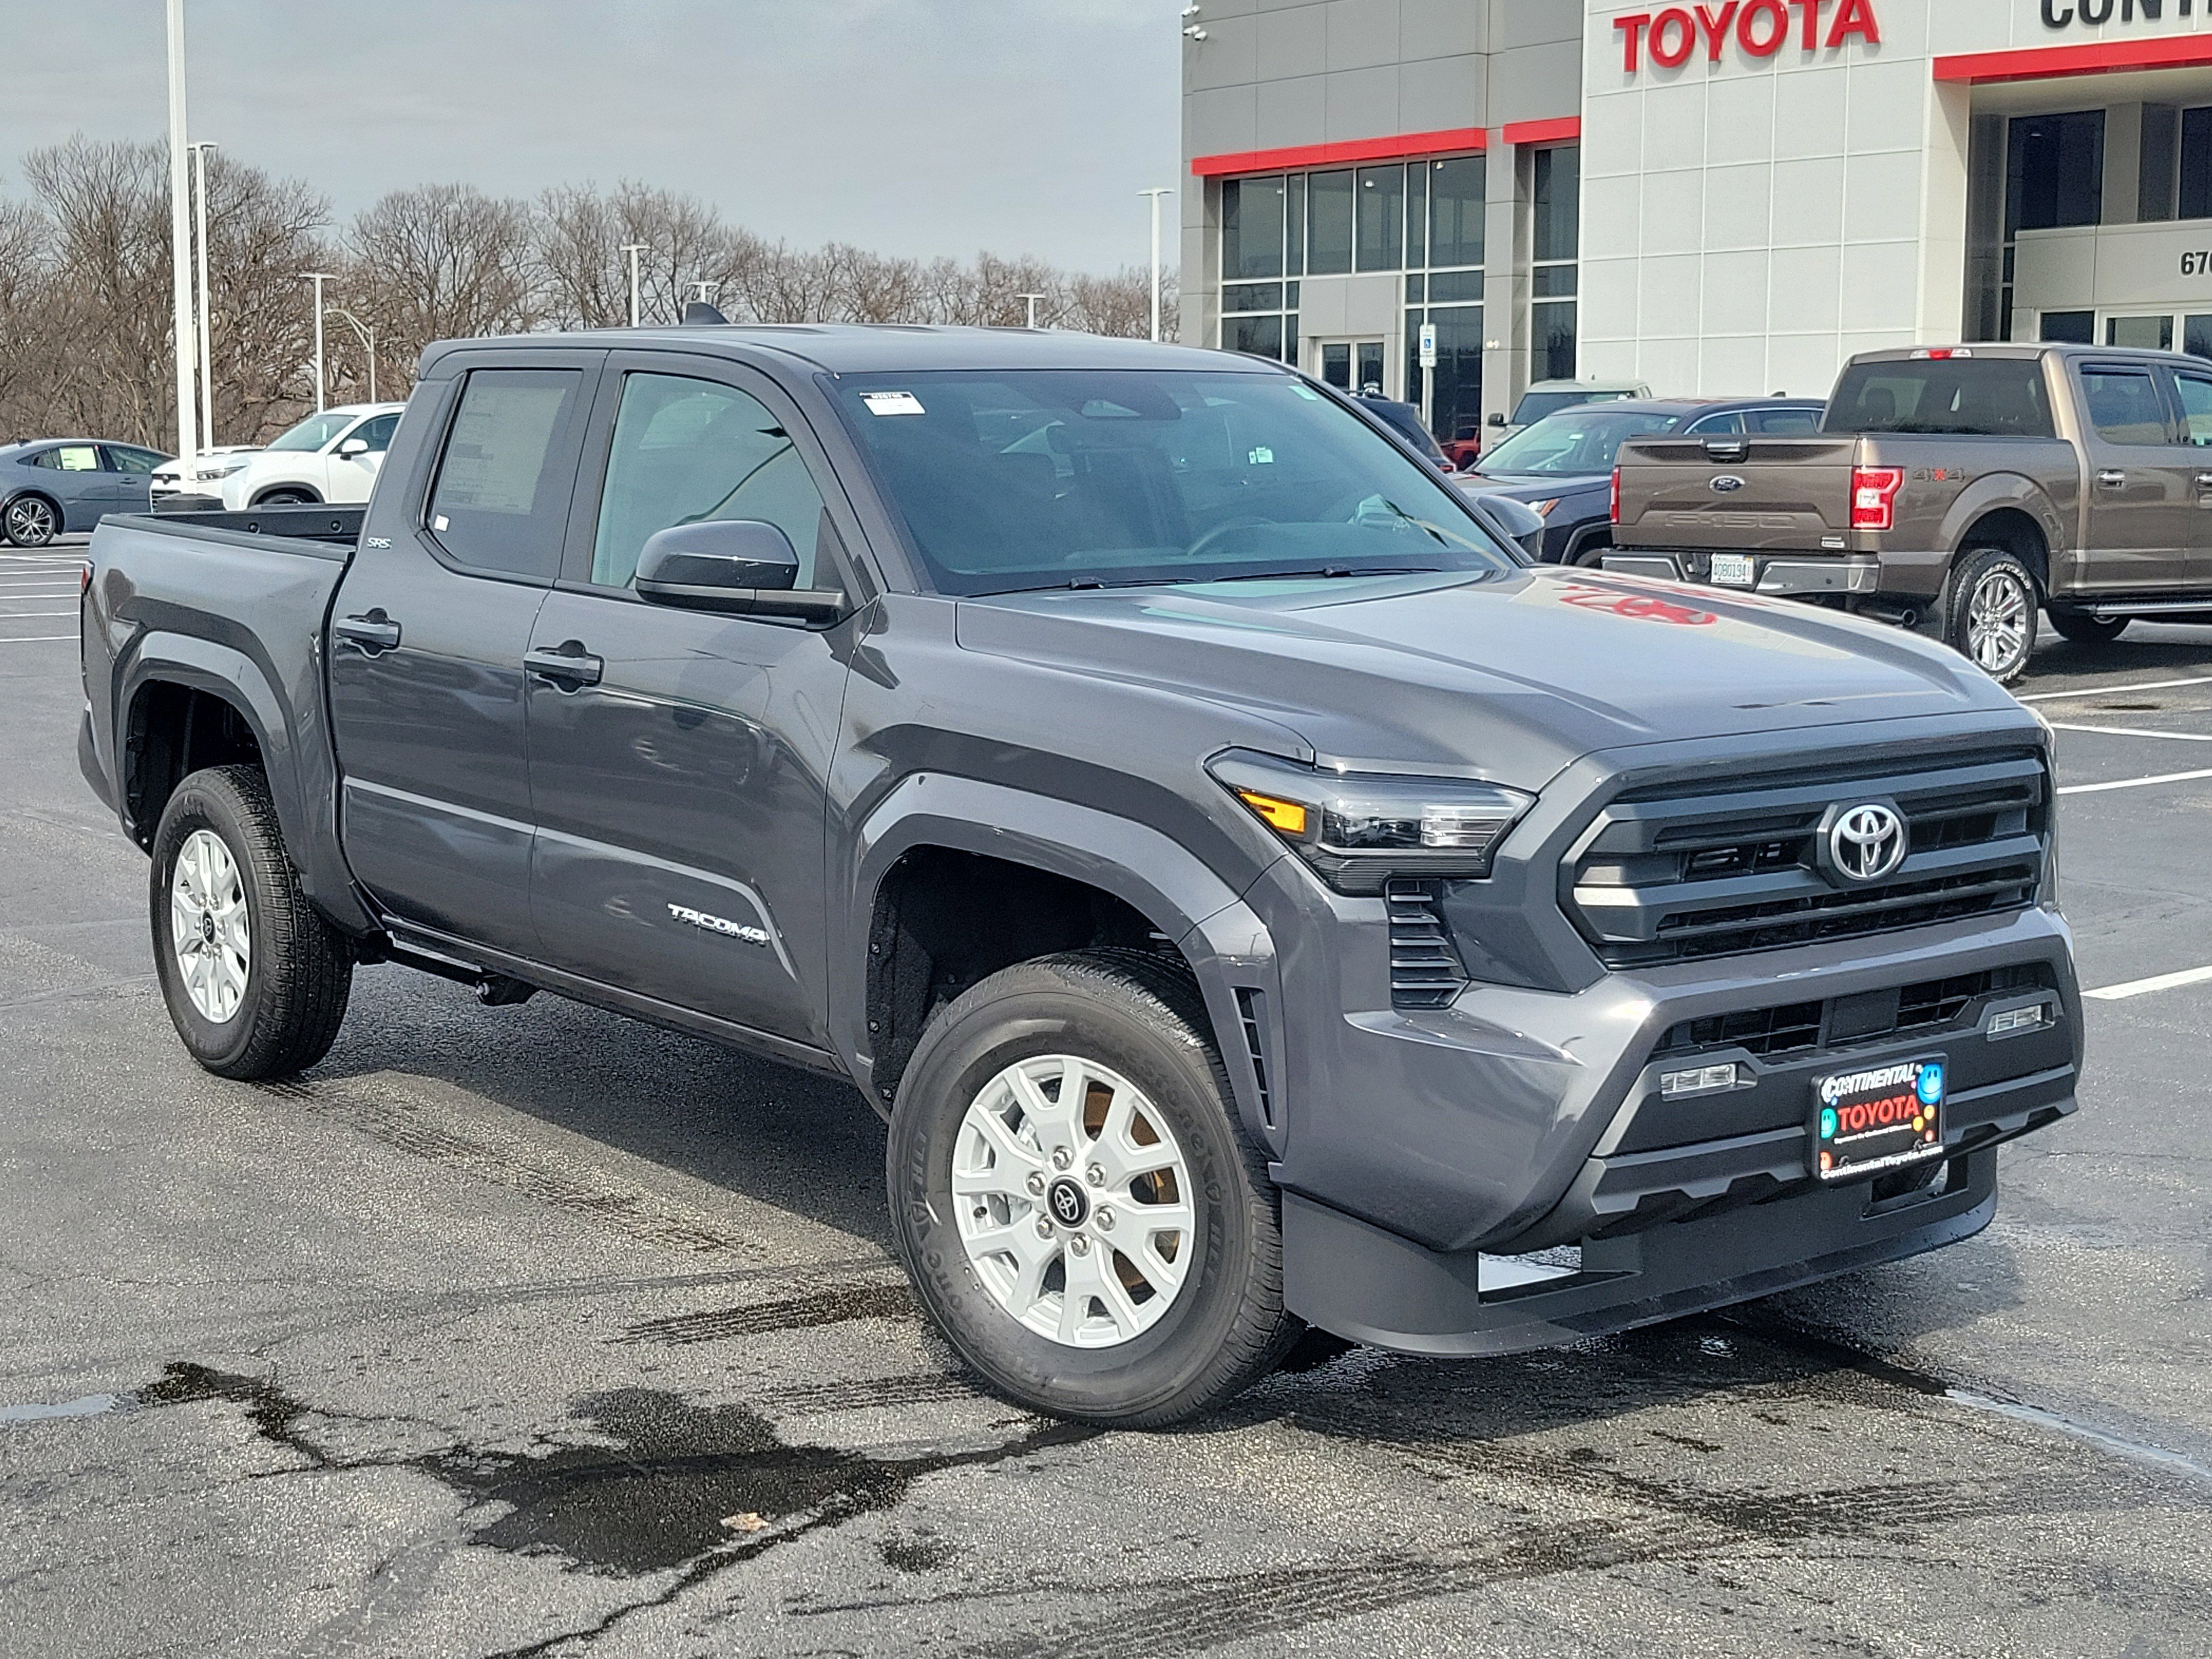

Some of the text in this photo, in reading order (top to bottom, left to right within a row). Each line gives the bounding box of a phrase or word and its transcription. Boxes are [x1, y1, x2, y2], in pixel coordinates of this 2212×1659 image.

[1613, 0, 1880, 72] TOYOTA
[2180, 251, 2212, 275] 67
[667, 902, 770, 944] TACOMA
[1821, 1063, 1916, 1103] CONTINENTAL
[1838, 1093, 1919, 1132] TOYOTA
[1820, 1146, 1943, 1179] ContinentalToyota.com
